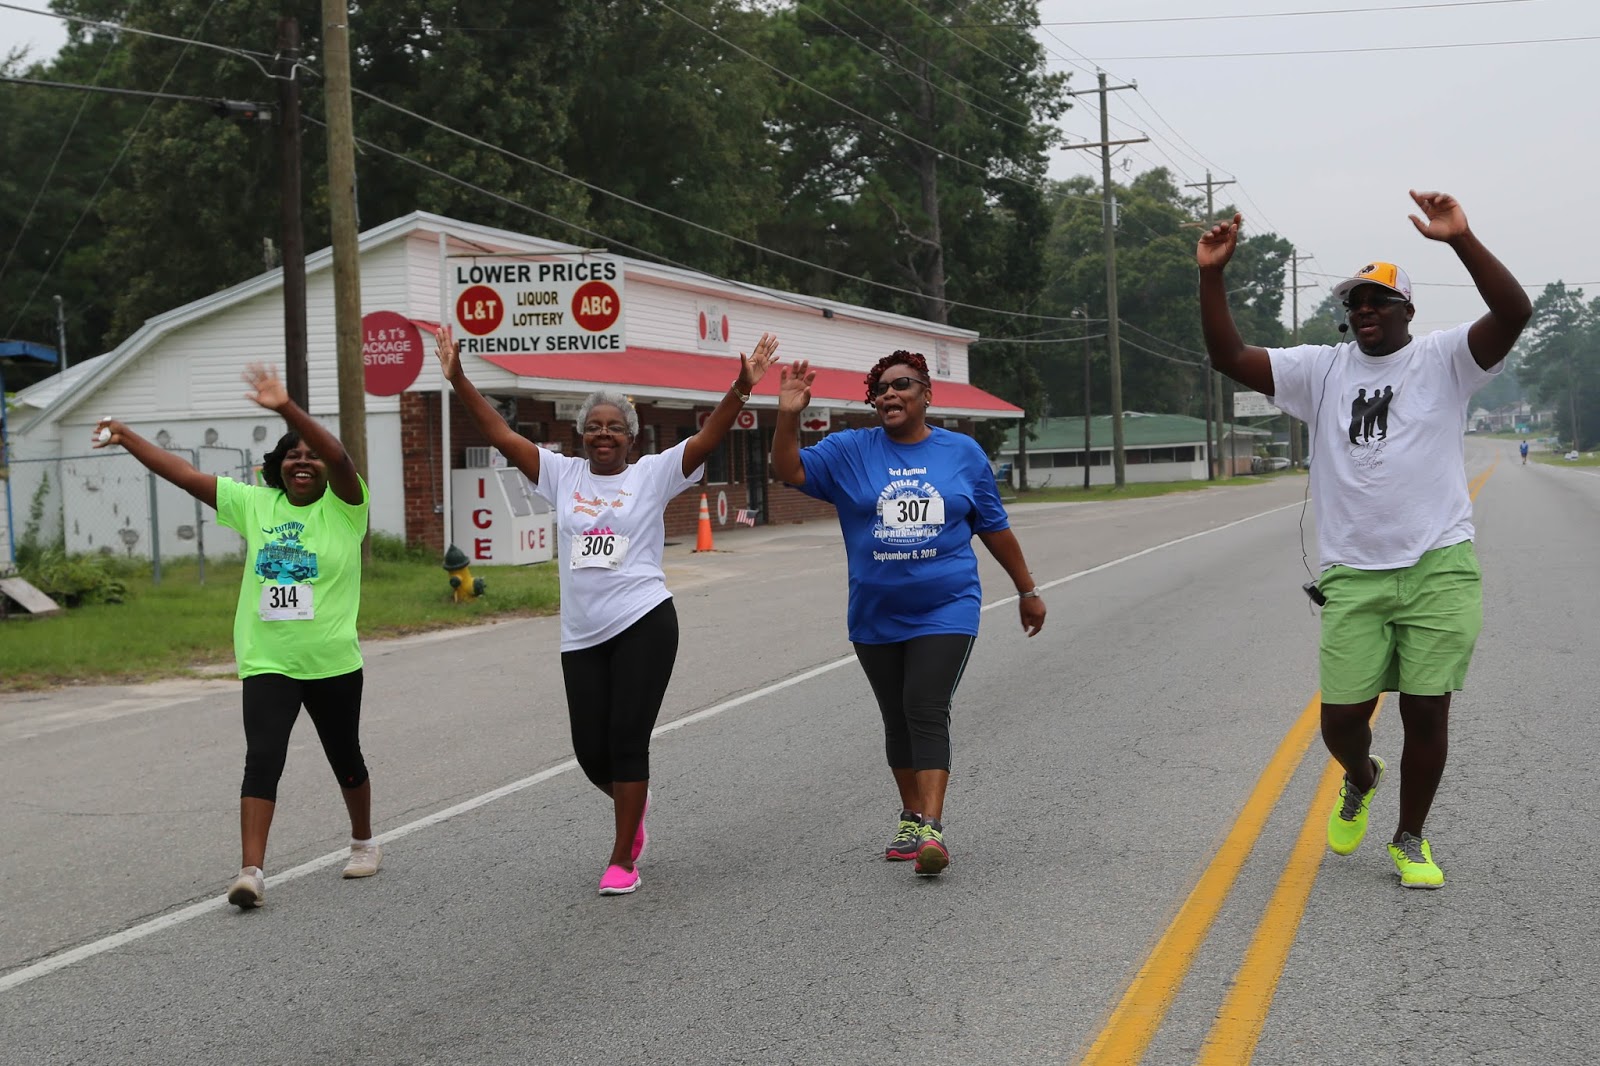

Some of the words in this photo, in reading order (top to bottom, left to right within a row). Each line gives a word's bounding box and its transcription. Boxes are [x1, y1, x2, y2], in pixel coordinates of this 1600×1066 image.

[457, 265, 531, 284] LOWER
[539, 262, 616, 282] PRICES
[517, 291, 558, 306] LIQUOR
[580, 296, 612, 316] ABC
[463, 300, 497, 320] L&T
[513, 312, 564, 326] LOTTERY
[362, 340, 411, 353] ACKAGE
[458, 336, 540, 353] FRIENDLY
[546, 334, 619, 351] SERVICE
[363, 353, 404, 365] STORE
[888, 467, 901, 476] 3rd
[902, 467, 927, 476] Annual
[472, 478, 492, 560] ICE
[897, 499, 930, 522] 307
[274, 521, 305, 533] EUTAWVIL
[520, 528, 545, 551] ICE
[581, 535, 615, 556] 306
[873, 550, 911, 562] September
[912, 550, 920, 560] 5,
[921, 548, 937, 559] 2015
[269, 586, 299, 609] 314
